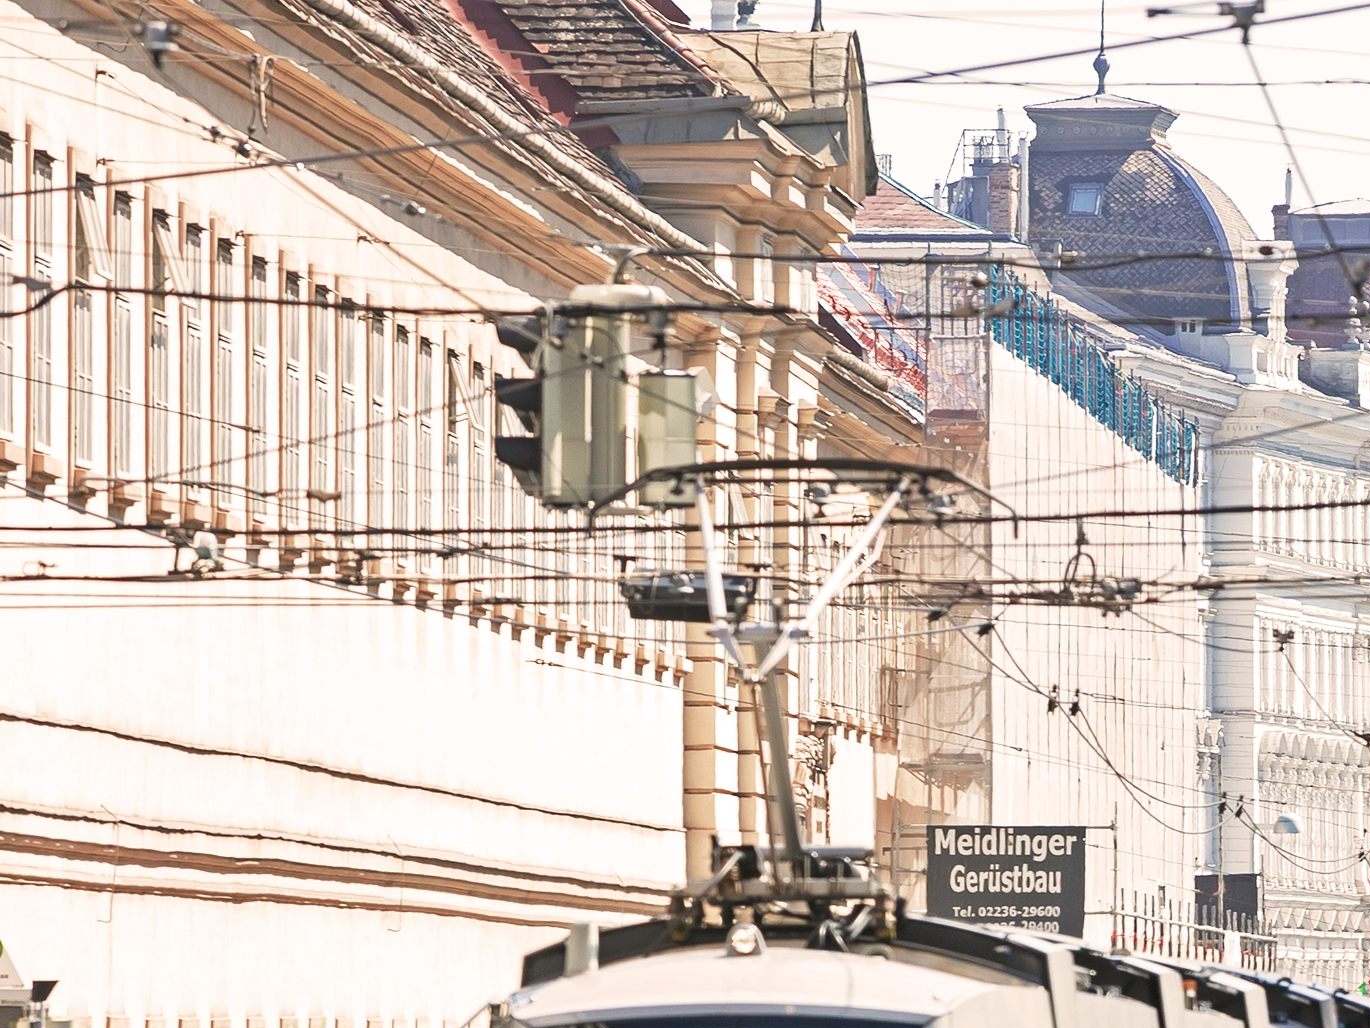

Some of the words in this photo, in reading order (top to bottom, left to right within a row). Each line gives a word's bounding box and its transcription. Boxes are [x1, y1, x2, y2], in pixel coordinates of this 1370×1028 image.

[934, 827, 1078, 862] Meidlinger
[949, 863, 1062, 894] Gerüstbau
[952, 906, 976, 917] Tel.
[978, 905, 1061, 918] 02236-29600
